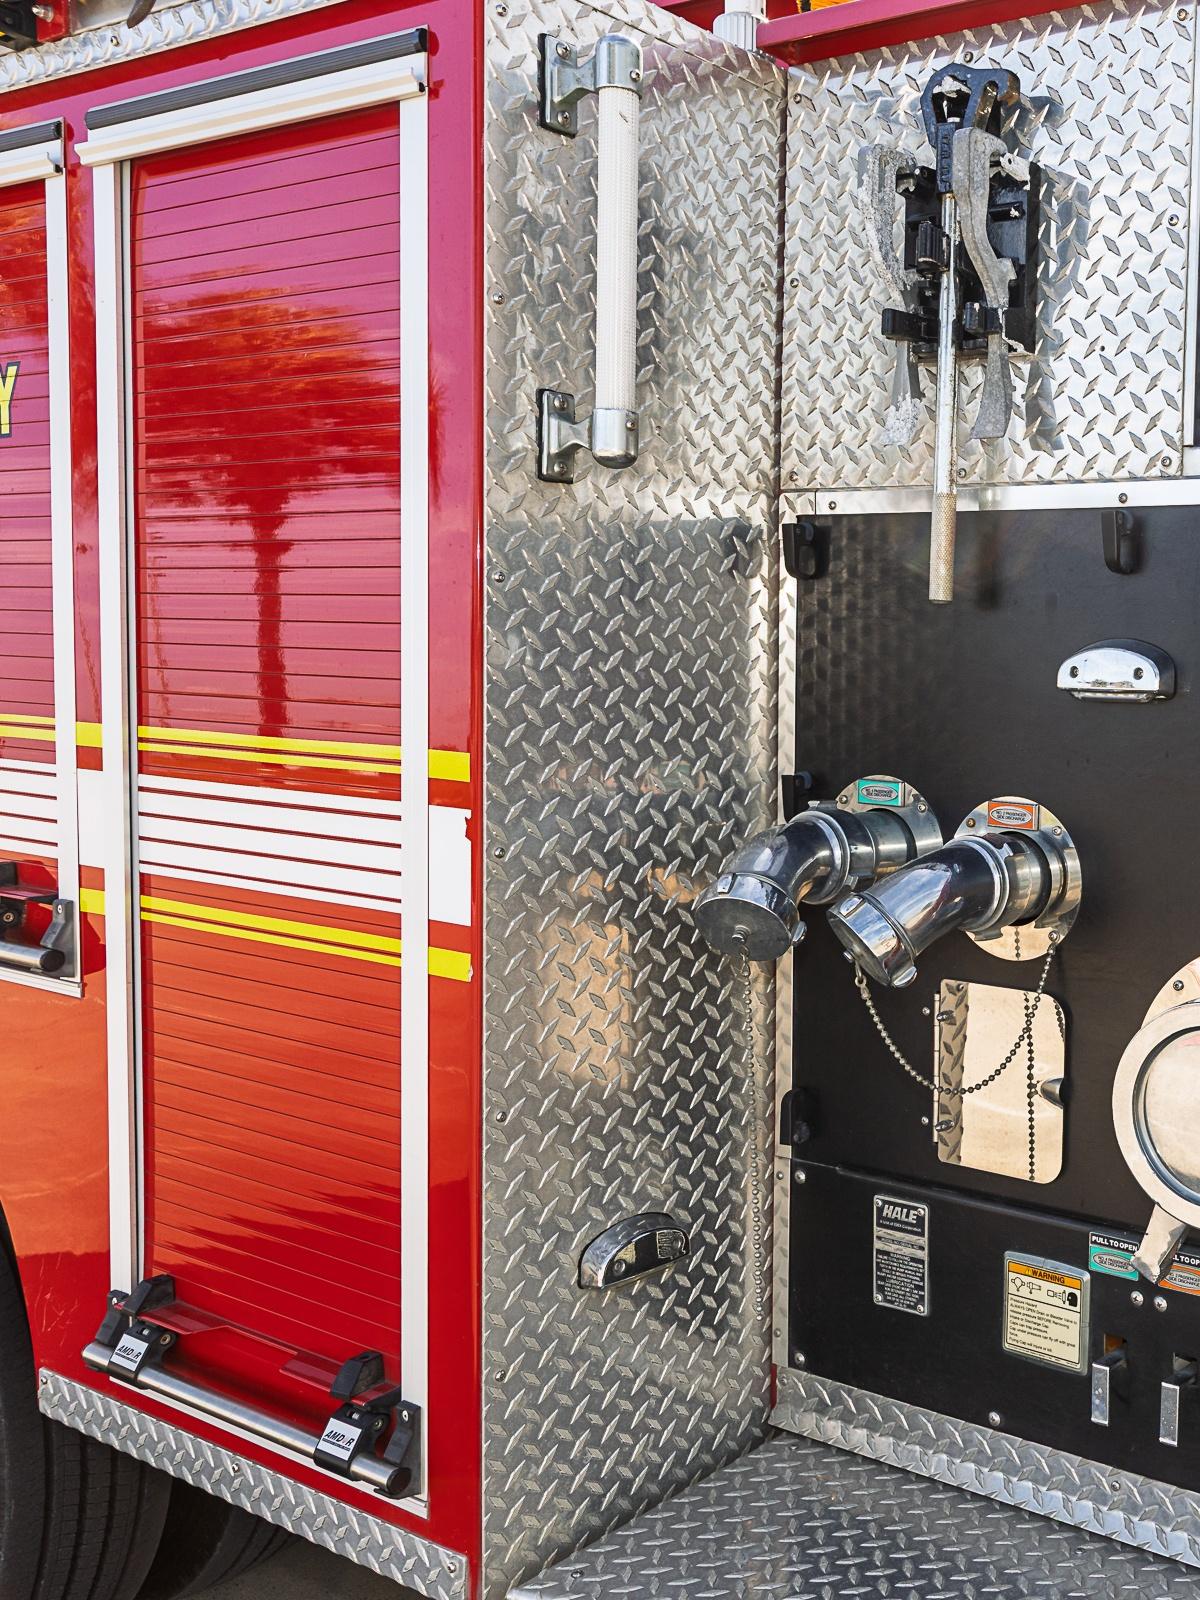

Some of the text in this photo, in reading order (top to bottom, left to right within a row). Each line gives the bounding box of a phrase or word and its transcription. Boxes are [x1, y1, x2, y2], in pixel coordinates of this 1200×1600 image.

[882, 1204, 917, 1224] HALE
[1092, 1235, 1138, 1252] PULL TO OPEN
[1180, 1255, 1190, 1263] TO
[1031, 1268, 1065, 1284] WARNING
